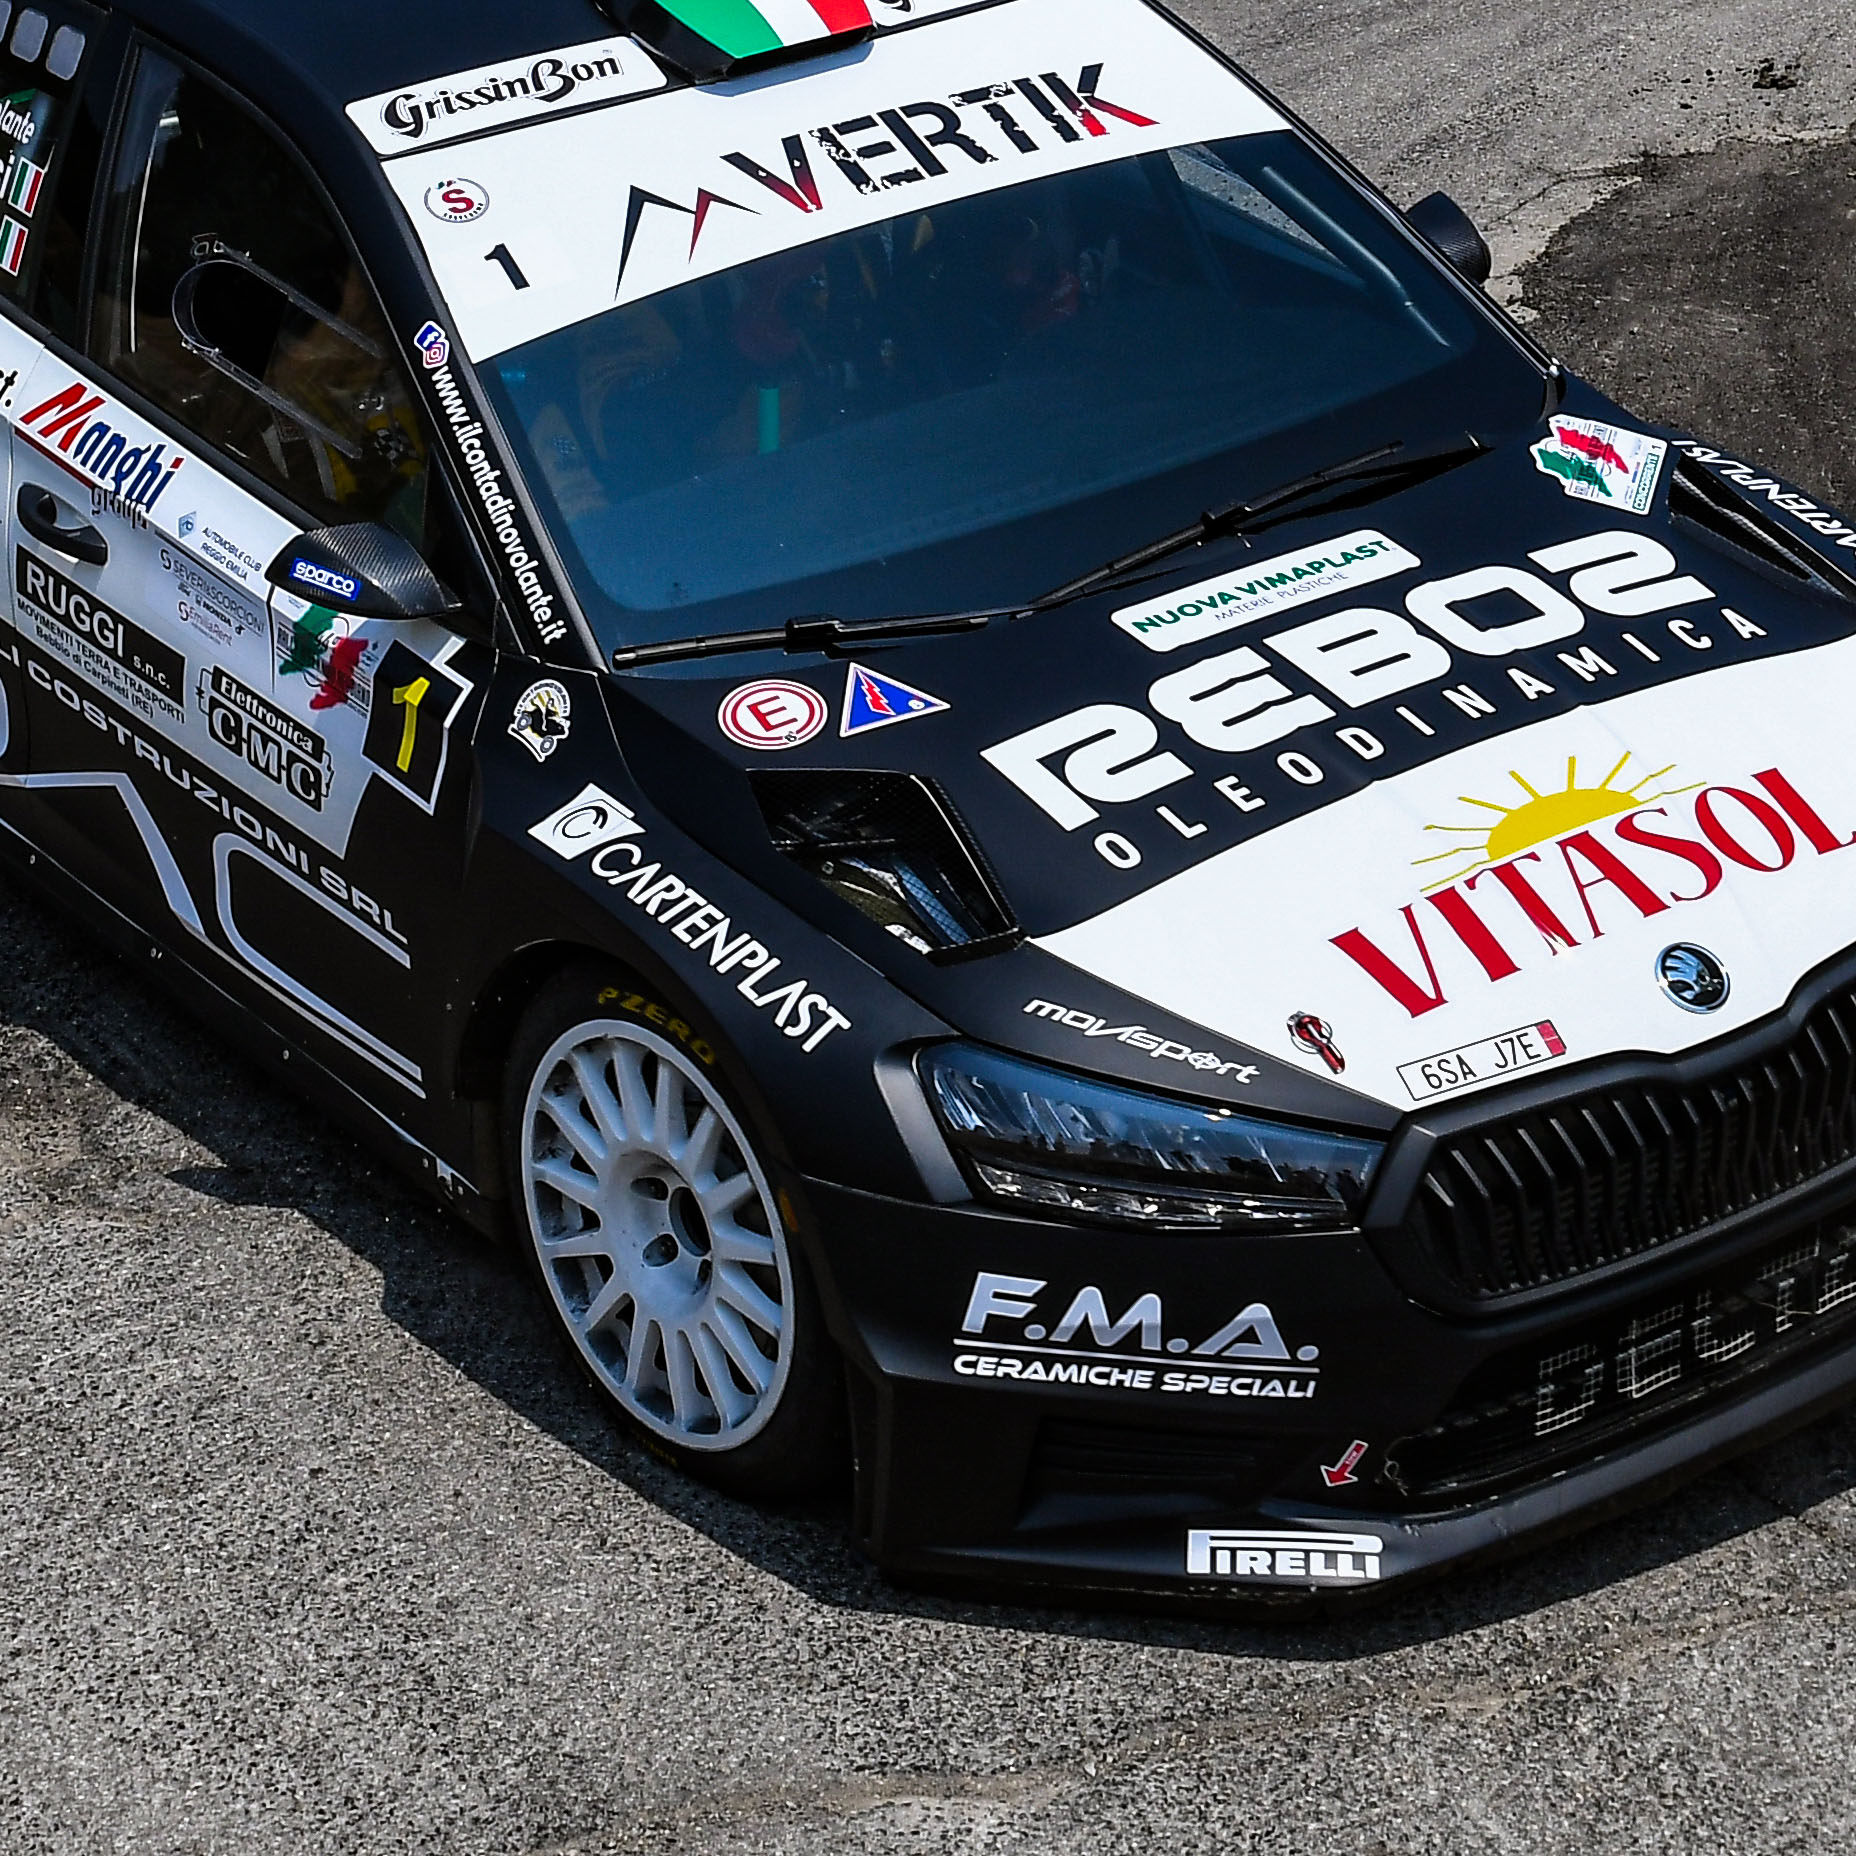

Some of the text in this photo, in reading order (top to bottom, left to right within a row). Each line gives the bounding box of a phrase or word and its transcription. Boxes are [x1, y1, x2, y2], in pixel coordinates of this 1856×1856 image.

[380, 56, 621, 138] GrissinBon
[720, 62, 1160, 215] VERTIK
[484, 242, 531, 292] 1
[19, 382, 185, 514] Manghi
[202, 527, 263, 572] AUTOMOBILE CLUB
[431, 365, 568, 645] www.ilcontadinovolante.it
[200, 542, 249, 581] REGGIO EMILIA
[295, 561, 355, 593] sparco
[1131, 539, 1391, 634] NUOVA VIMAPLAST
[1214, 571, 1350, 622] MATERIE PLASTICHE
[17, 597, 185, 725] MOVIMENTI TERRA E TRASPORTI
[26, 560, 171, 690] RUGGI s.n.c.
[36, 625, 155, 719] Bebbio di Carpineti (RE)
[220, 675, 314, 754] Elettronica
[746, 695, 798, 732] E
[393, 676, 430, 773] 1
[1093, 611, 1768, 871] OLEODINAMICA
[27, 660, 311, 876] COSTRUZIONI
[319, 865, 410, 945] SRL
[591, 843, 852, 1053] CARTENPLAST
[1022, 997, 1262, 1086] movisport
[1420, 1032, 1542, 1090] 6SA J7E
[961, 1272, 1321, 1361] F.M.A.
[953, 1353, 1320, 1399] CERAMICHE SPECIALI
[1186, 1529, 1383, 1579] PIRELLI
